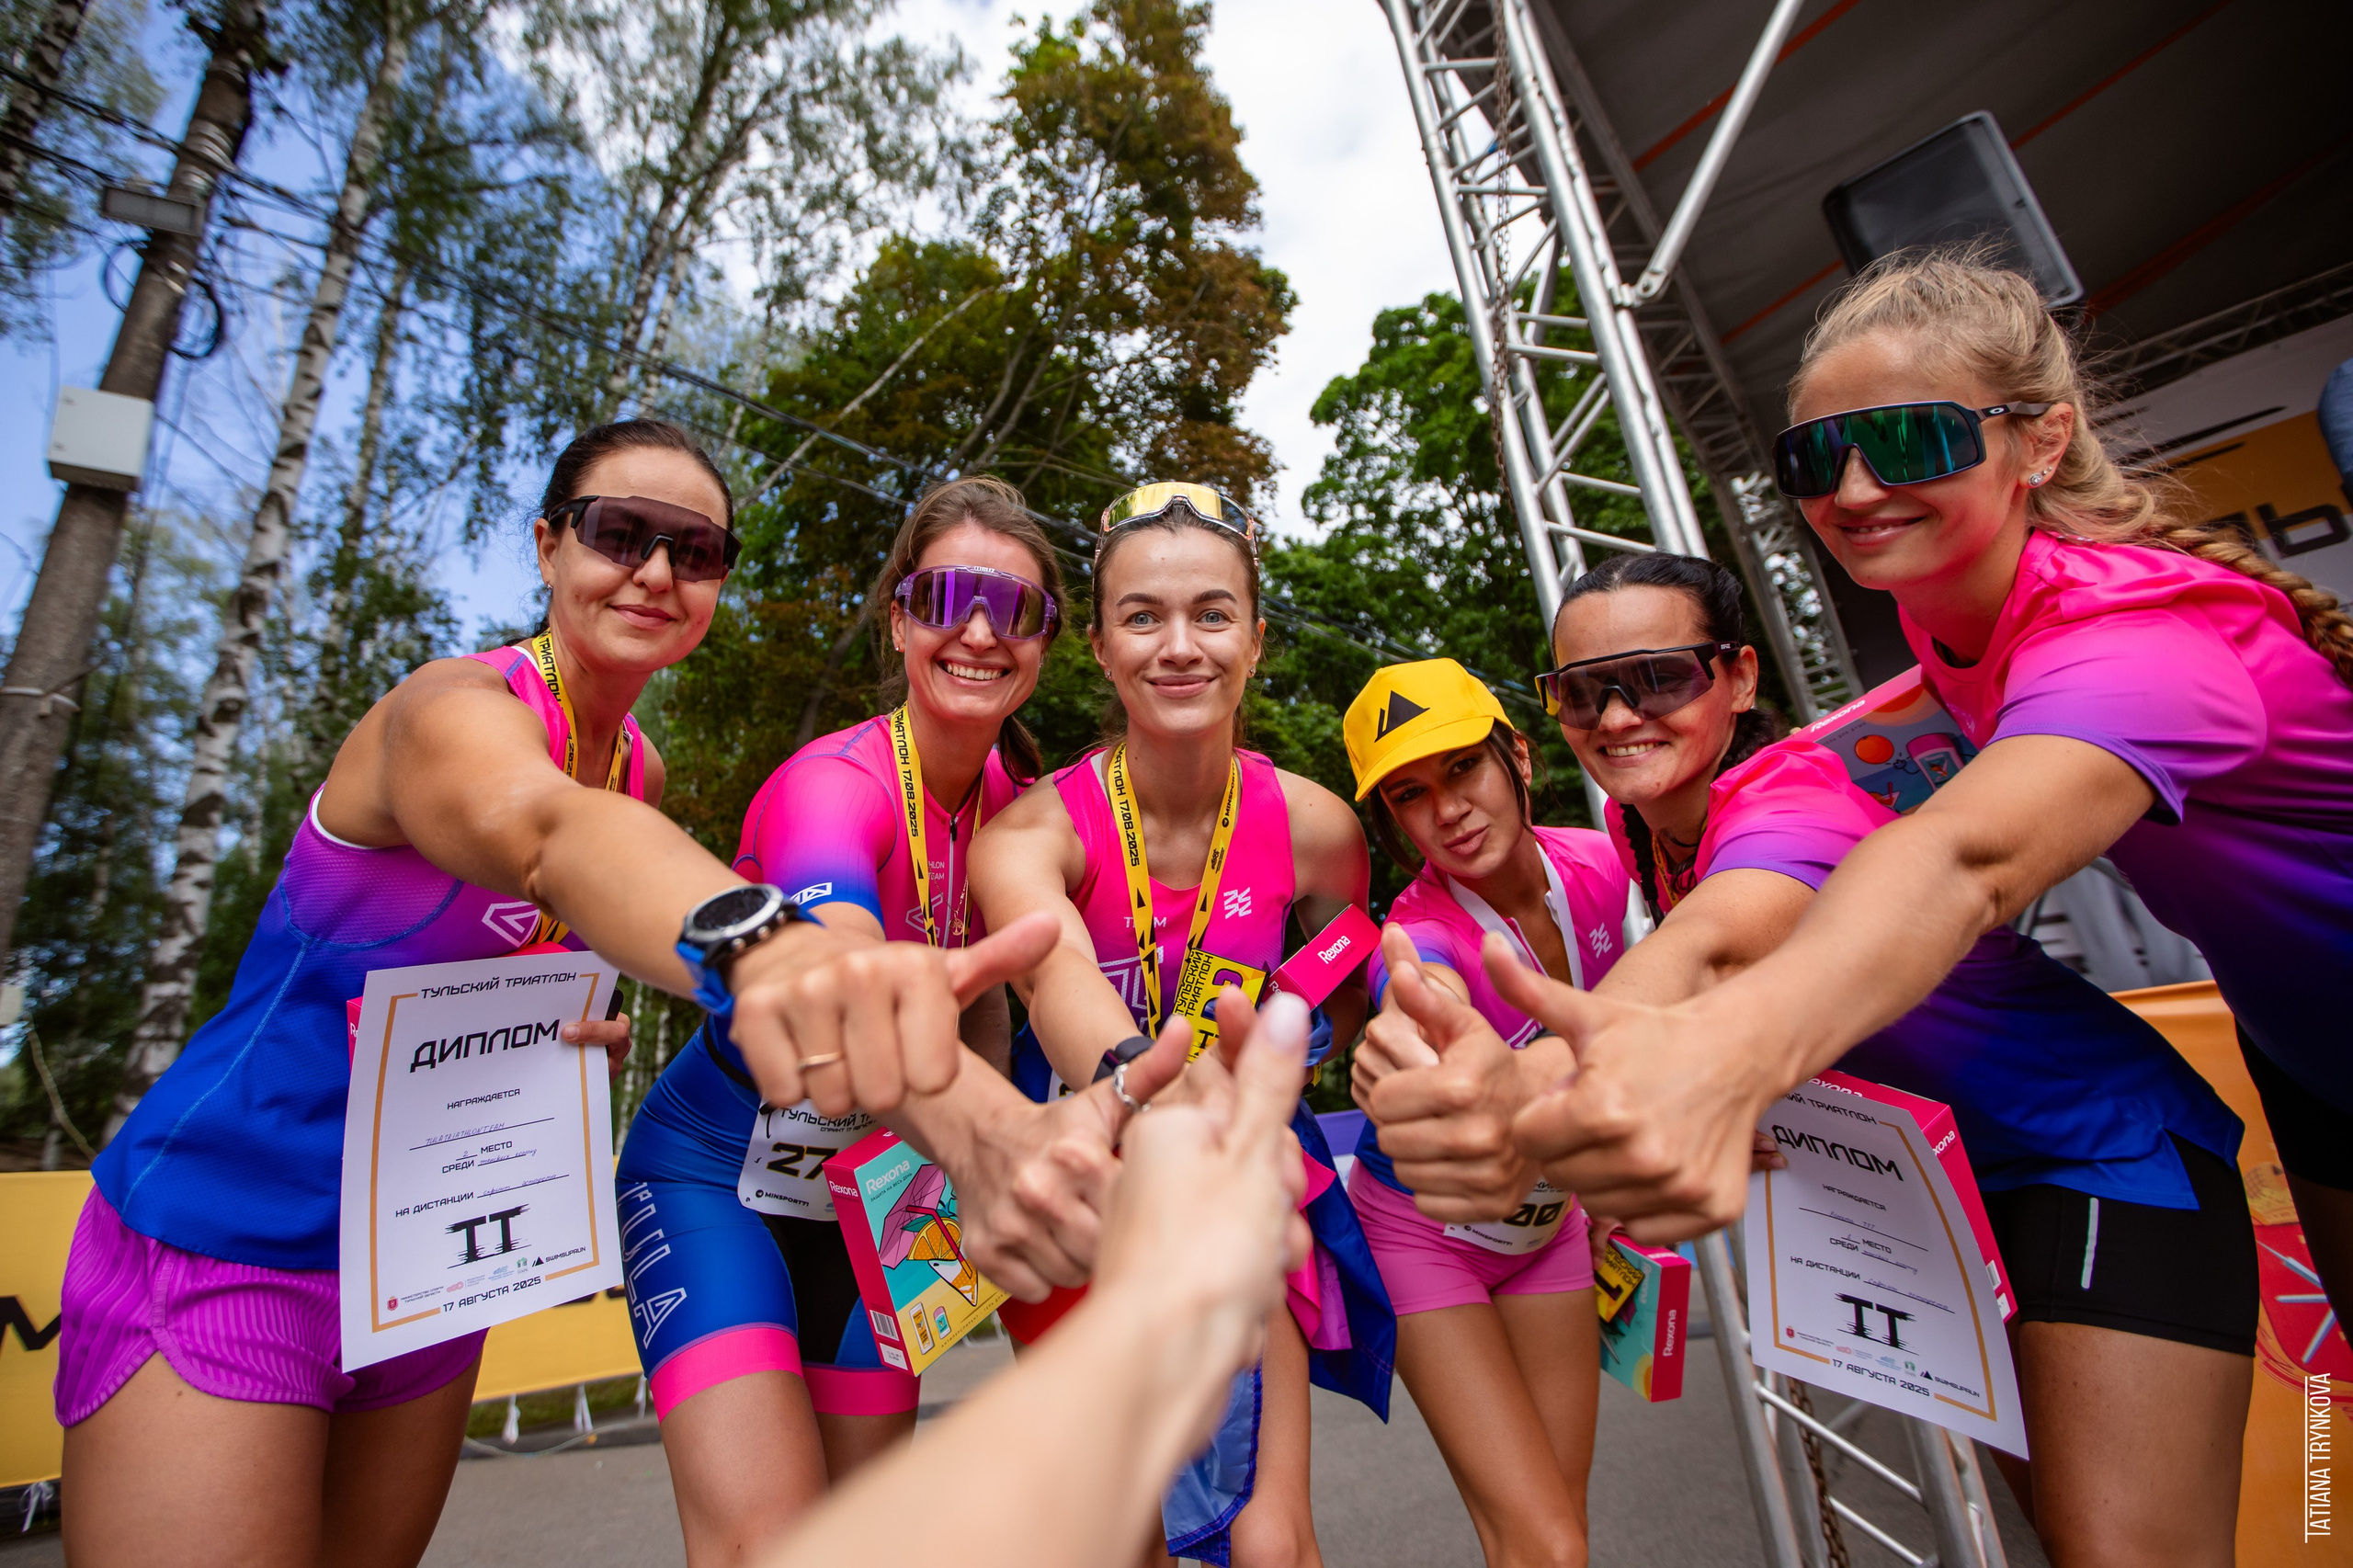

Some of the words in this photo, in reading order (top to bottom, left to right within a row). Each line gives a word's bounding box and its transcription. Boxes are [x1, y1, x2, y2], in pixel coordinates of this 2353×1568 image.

[1811, 699, 1866, 733] Rexona
[894, 710, 910, 765] ТРИАТЛОН
[903, 769, 919, 837] 17.08.2025
[1119, 799, 1140, 867] 17.08.2025
[1123, 916, 1167, 928] TM
[1317, 935, 1351, 964] Rexona
[421, 976, 500, 999] ТУЛЬСКИЙ
[505, 971, 577, 989] ТРИАТЛОН
[1175, 950, 1204, 1015] ТУЛЬСКИЙ
[1184, 954, 1214, 1017] ТРИАТЛОН
[409, 1018, 561, 1074] ДИПЛОМ
[447, 1088, 521, 1110] НАГРАЖДАЕТСЯ
[1807, 1098, 1878, 1125] ТРИАТЛОН
[779, 1107, 857, 1127] ТУЛЬСКИЙ
[480, 1140, 513, 1154] МЕСТО
[1770, 1124, 1904, 1182] ДИПЛОМ
[1932, 1130, 1956, 1156] xona
[441, 1160, 475, 1174] СРЕДИ
[865, 1160, 911, 1196] Rexona
[765, 1191, 810, 1207] MINSPORT71
[828, 1180, 858, 1198] Rexona
[1822, 1184, 1887, 1211] НАГРАЖДАЕТСЯ
[395, 1207, 410, 1218] НА
[413, 1191, 474, 1214] ДИСТАНЦИИ
[545, 1246, 586, 1263] SWIMSUPRUN
[1829, 1237, 1859, 1252] СРЕДИ
[1861, 1238, 1893, 1254] МЕСТО
[1607, 1246, 1642, 1281] УЛЬСКИЙ
[1790, 1256, 1803, 1267] НА
[1805, 1259, 1861, 1280] ДИСТАНЦИИ
[442, 1301, 454, 1312] 17
[458, 1285, 509, 1309] АВГУСТА
[512, 1276, 541, 1292] 2025
[1662, 1309, 1677, 1358] Rexona
[1832, 1358, 1844, 1368] 17
[1846, 1363, 1897, 1386] АВГУСТА
[1899, 1379, 1930, 1397] 2025
